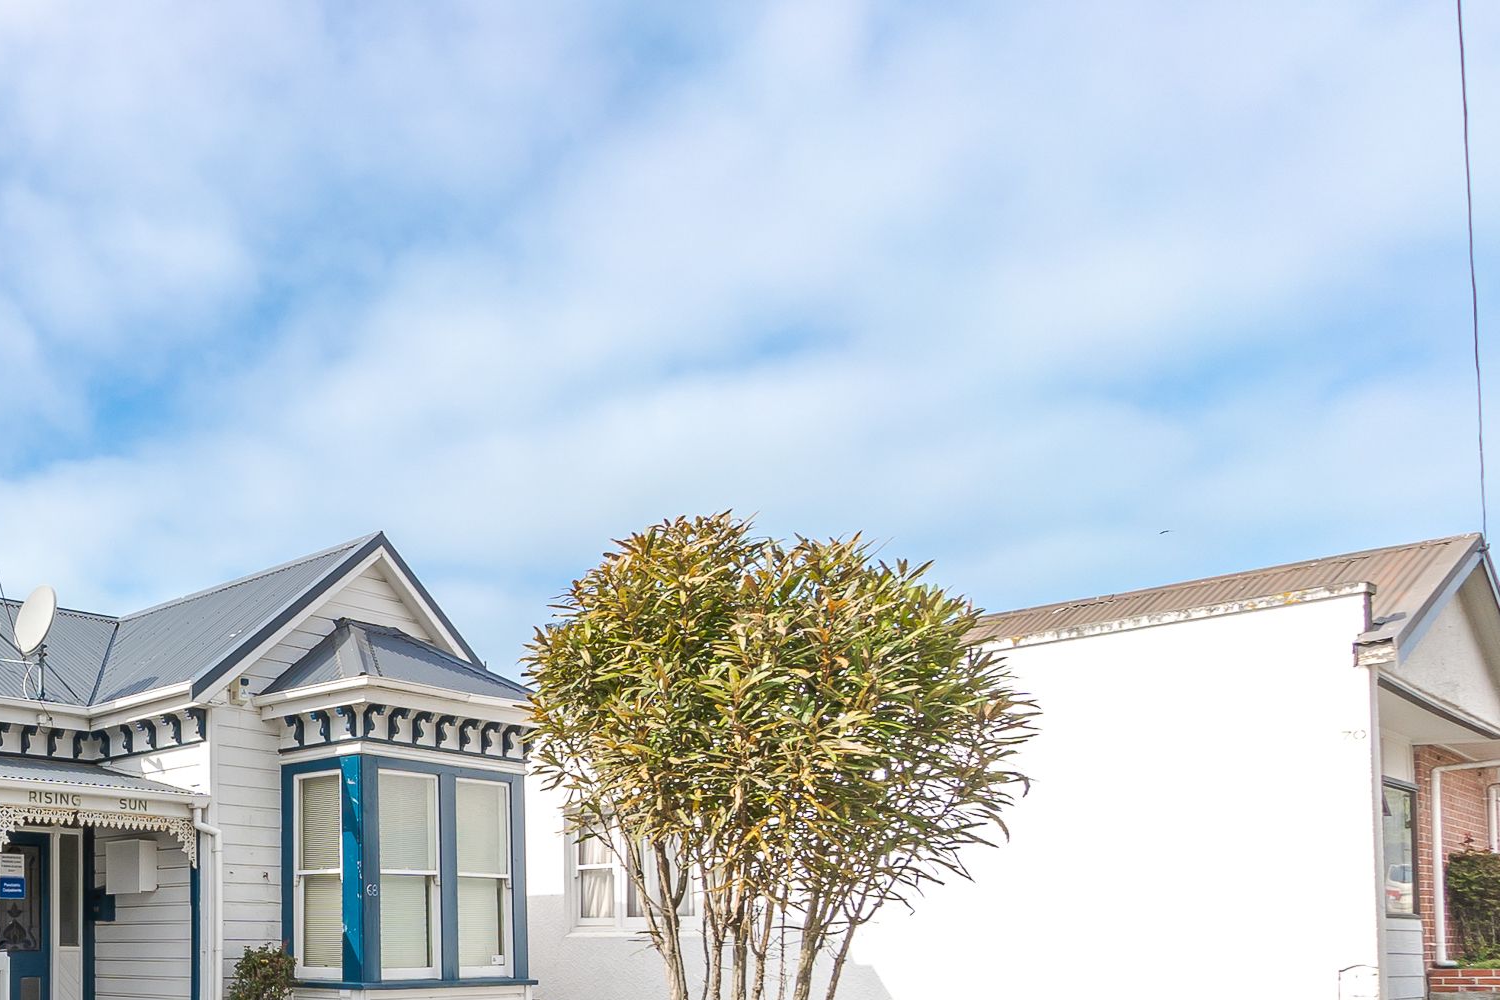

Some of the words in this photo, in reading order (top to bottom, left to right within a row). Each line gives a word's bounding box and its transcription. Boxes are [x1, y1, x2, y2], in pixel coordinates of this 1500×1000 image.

[28, 790, 82, 807] RISING
[119, 798, 148, 812] SUN
[366, 883, 379, 897] 68
